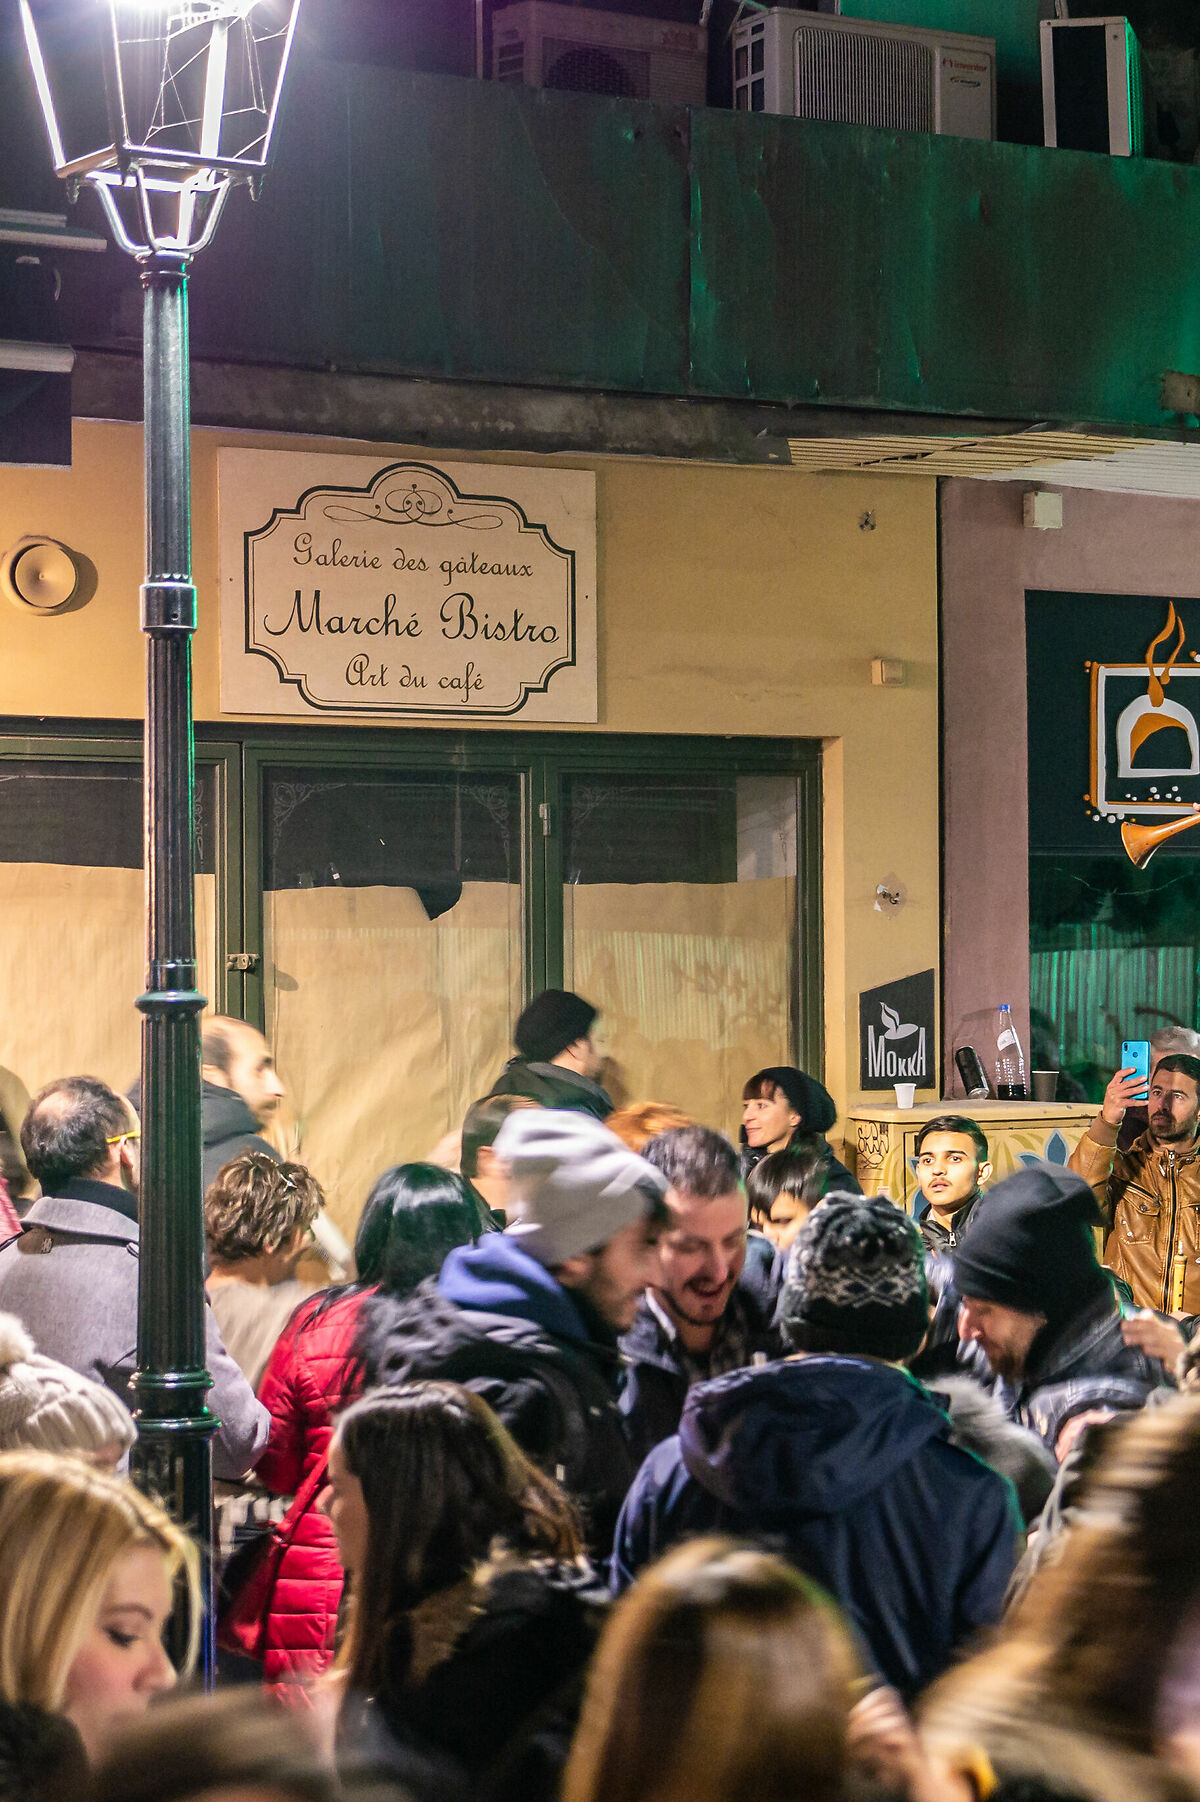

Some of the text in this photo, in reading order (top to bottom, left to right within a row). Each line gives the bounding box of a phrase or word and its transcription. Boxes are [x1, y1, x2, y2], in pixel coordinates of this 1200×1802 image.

[293, 532, 382, 570] Galerie
[392, 548, 429, 572] des
[263, 590, 560, 643] Marché Bistro
[345, 653, 485, 703] Art du café
